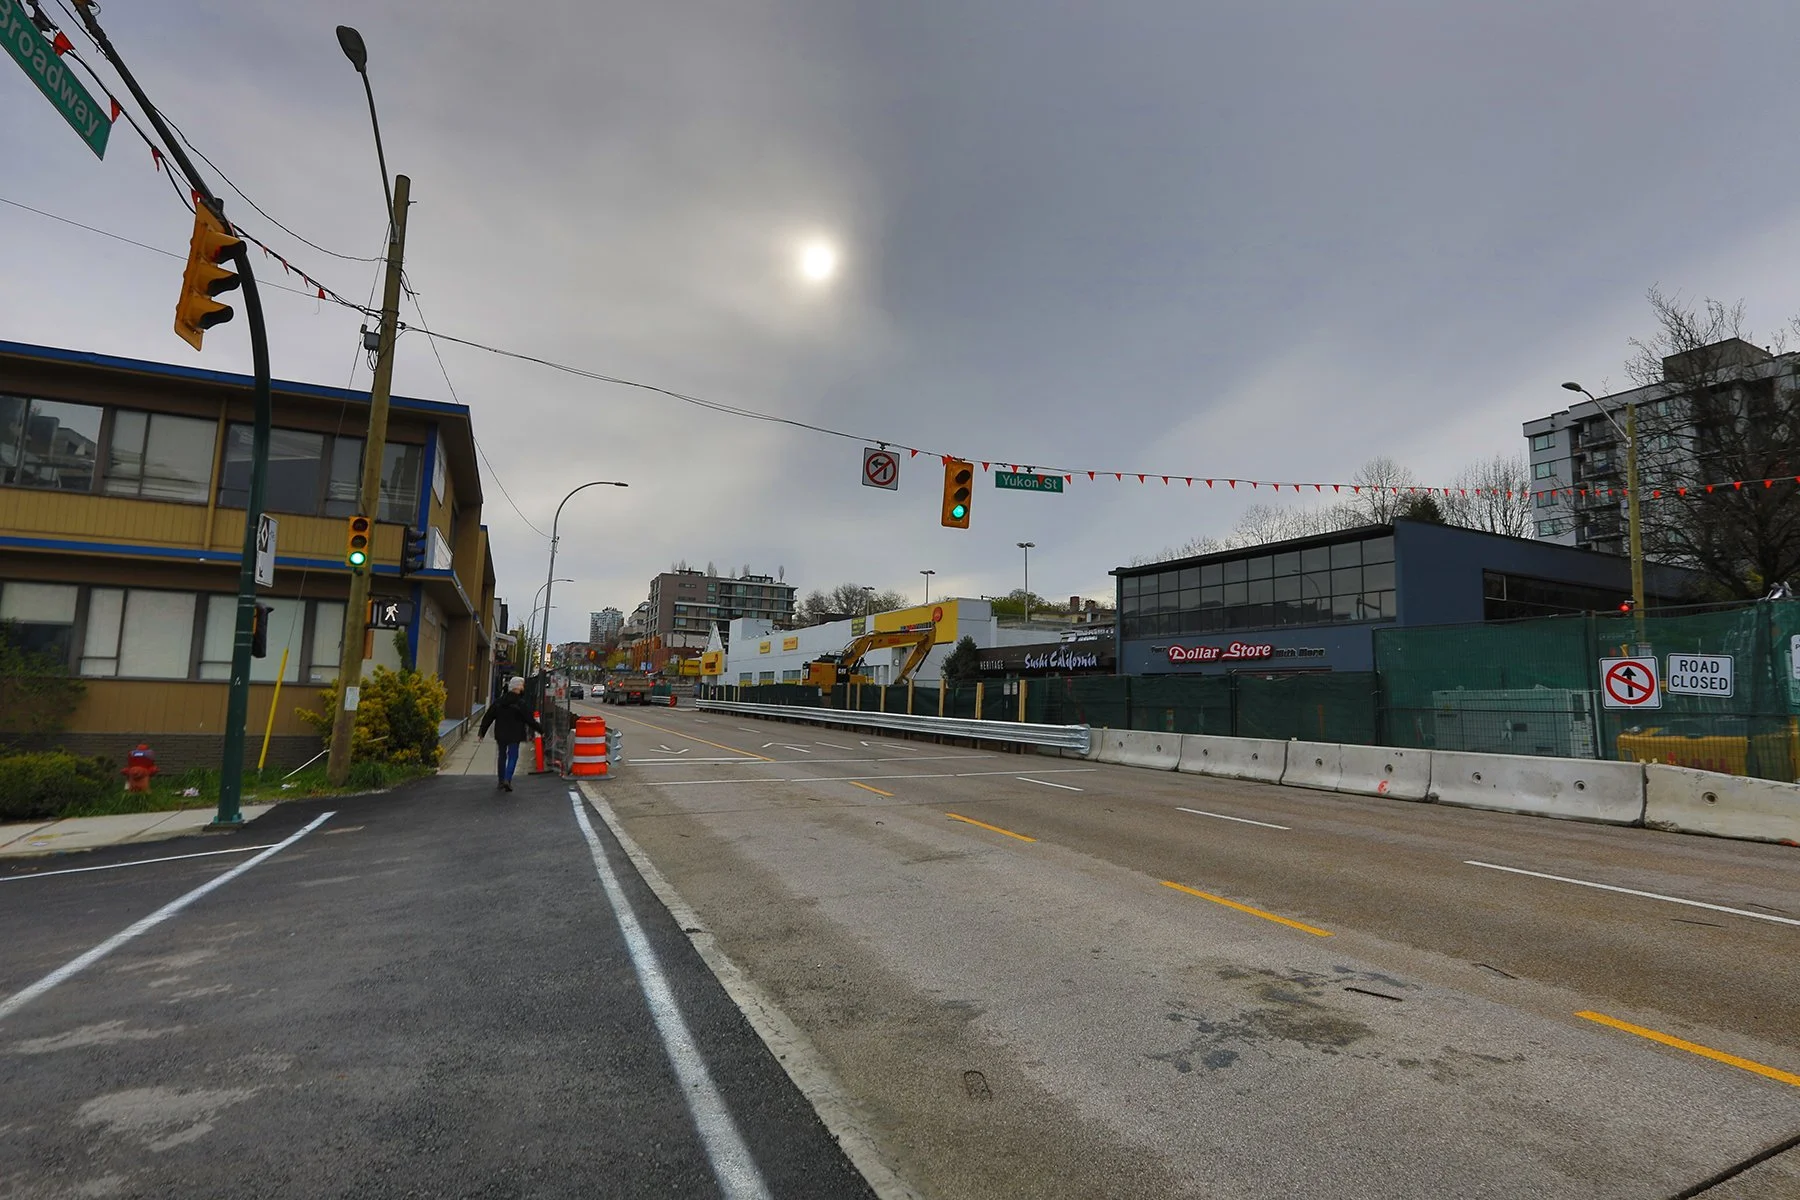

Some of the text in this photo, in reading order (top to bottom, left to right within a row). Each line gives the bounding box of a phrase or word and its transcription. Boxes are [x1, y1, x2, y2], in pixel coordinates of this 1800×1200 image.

[1002, 474, 1057, 490] Yukon St
[1169, 646, 1220, 660] Dollar
[1222, 642, 1271, 658] Store
[1024, 651, 1098, 671] Sushi California
[1679, 659, 1720, 674] ROAD
[1671, 675, 1728, 690] CLOSED
